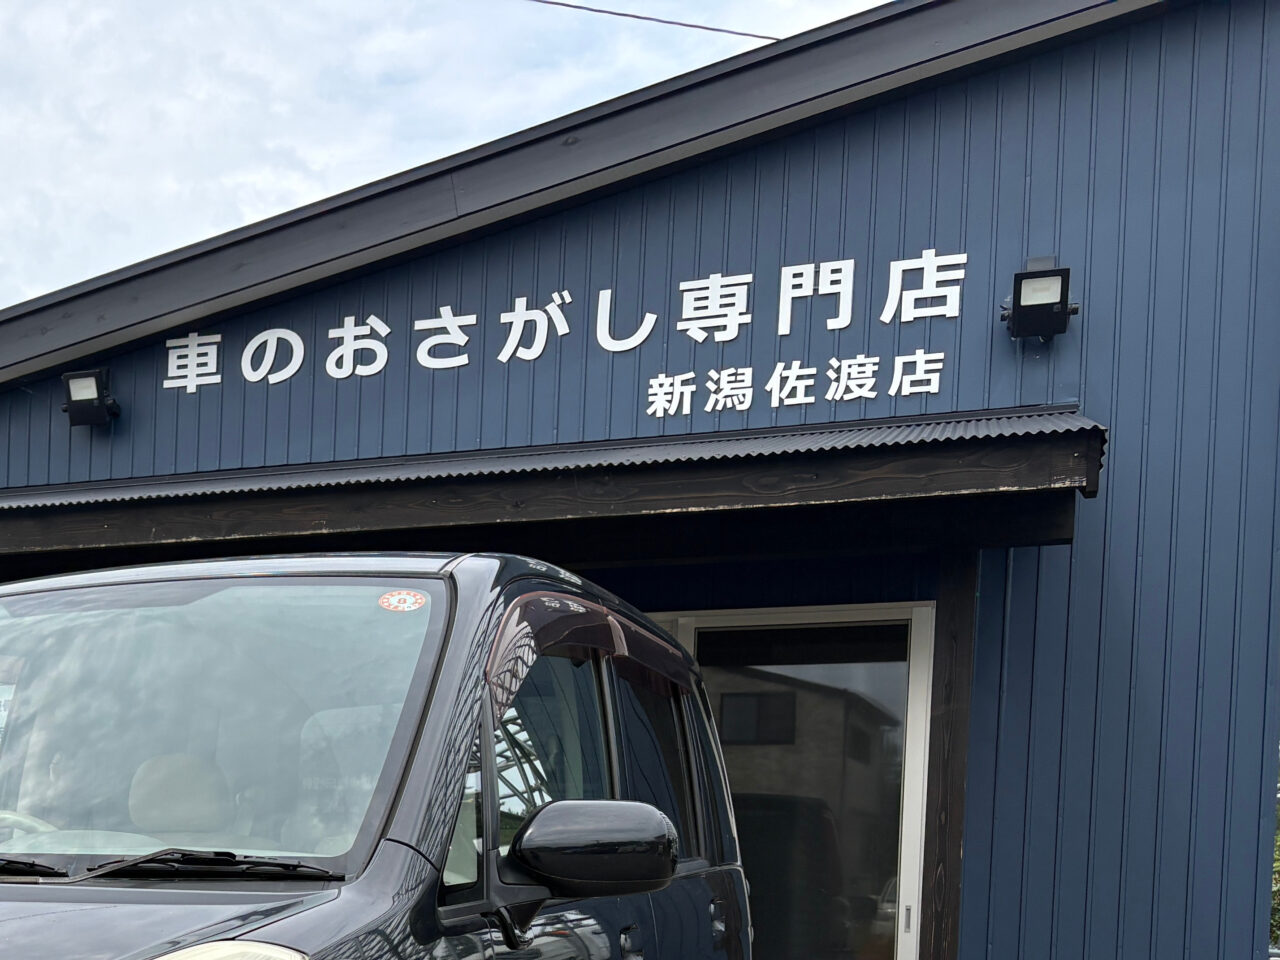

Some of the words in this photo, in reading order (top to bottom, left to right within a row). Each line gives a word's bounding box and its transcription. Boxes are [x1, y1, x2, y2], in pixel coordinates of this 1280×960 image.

[162, 249, 969, 394] 車のおさがし専門店
[646, 350, 946, 418] 新潟佐渡店
